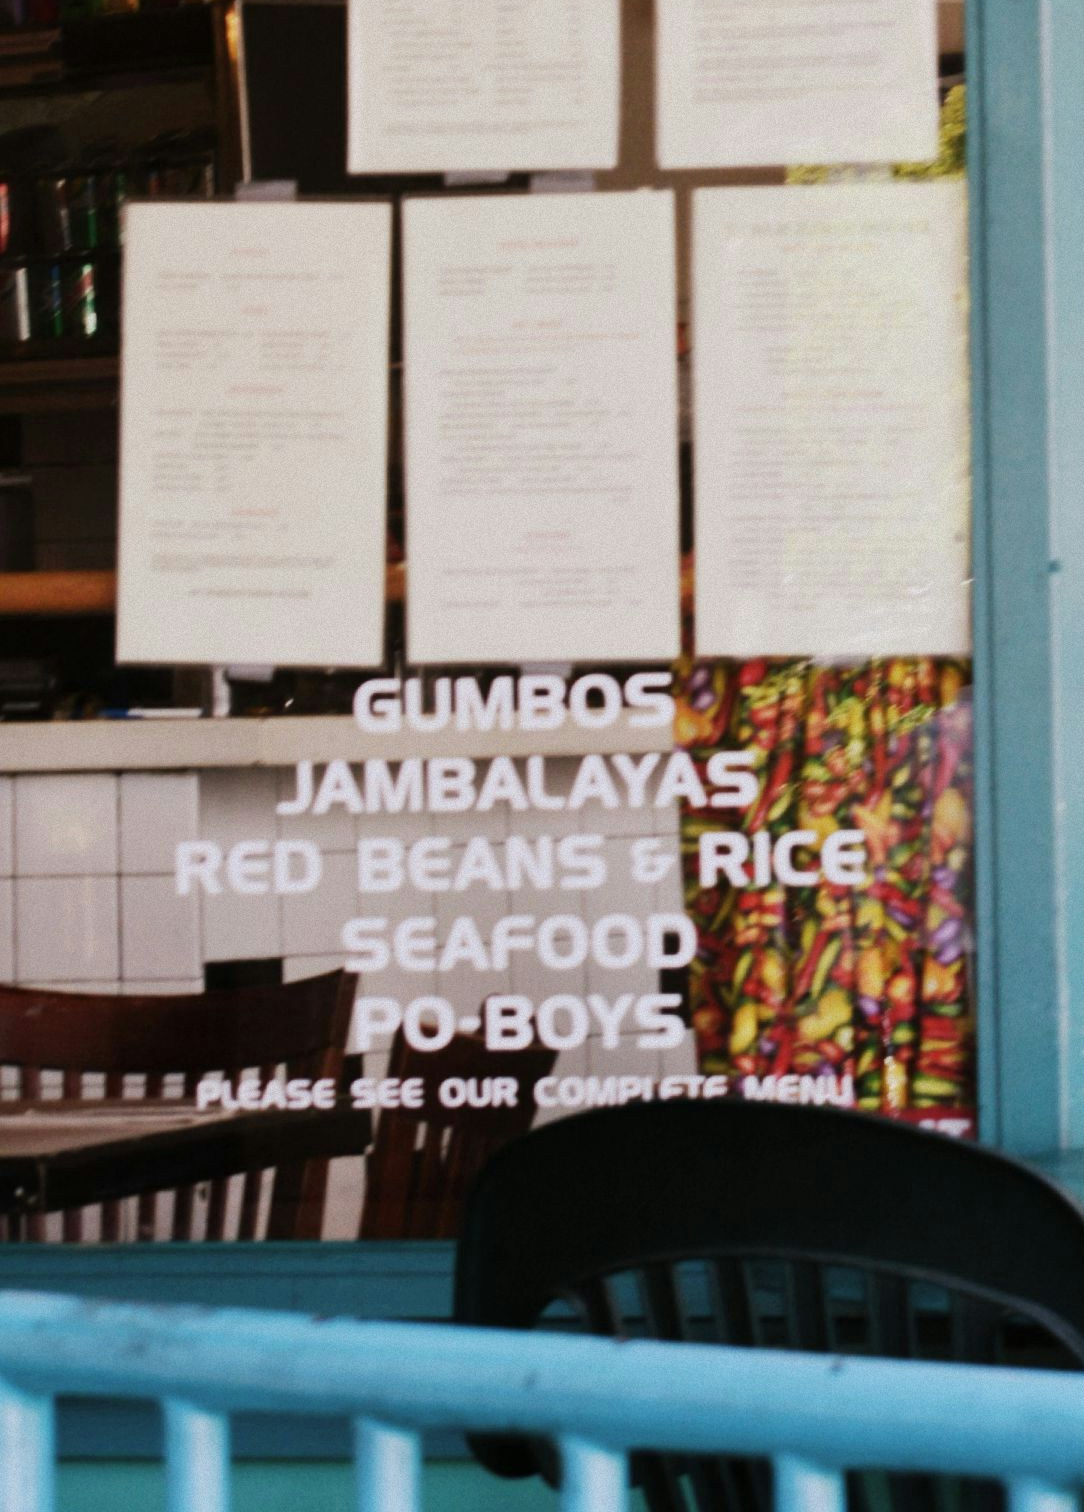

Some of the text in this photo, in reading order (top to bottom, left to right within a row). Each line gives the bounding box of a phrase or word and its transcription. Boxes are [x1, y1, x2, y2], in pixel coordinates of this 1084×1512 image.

[353, 672, 678, 735] GUMBOS
[277, 750, 760, 816] JAMBALAYAS
[175, 829, 867, 896] RED BEANS & RICE
[340, 914, 698, 973] SEAFOOD
[355, 993, 686, 1053] PO-BOYS
[196, 1077, 337, 1109] PLEASE
[350, 1078, 425, 1109] SEE
[439, 1077, 518, 1108] OUR
[744, 1073, 854, 1106] MENU
